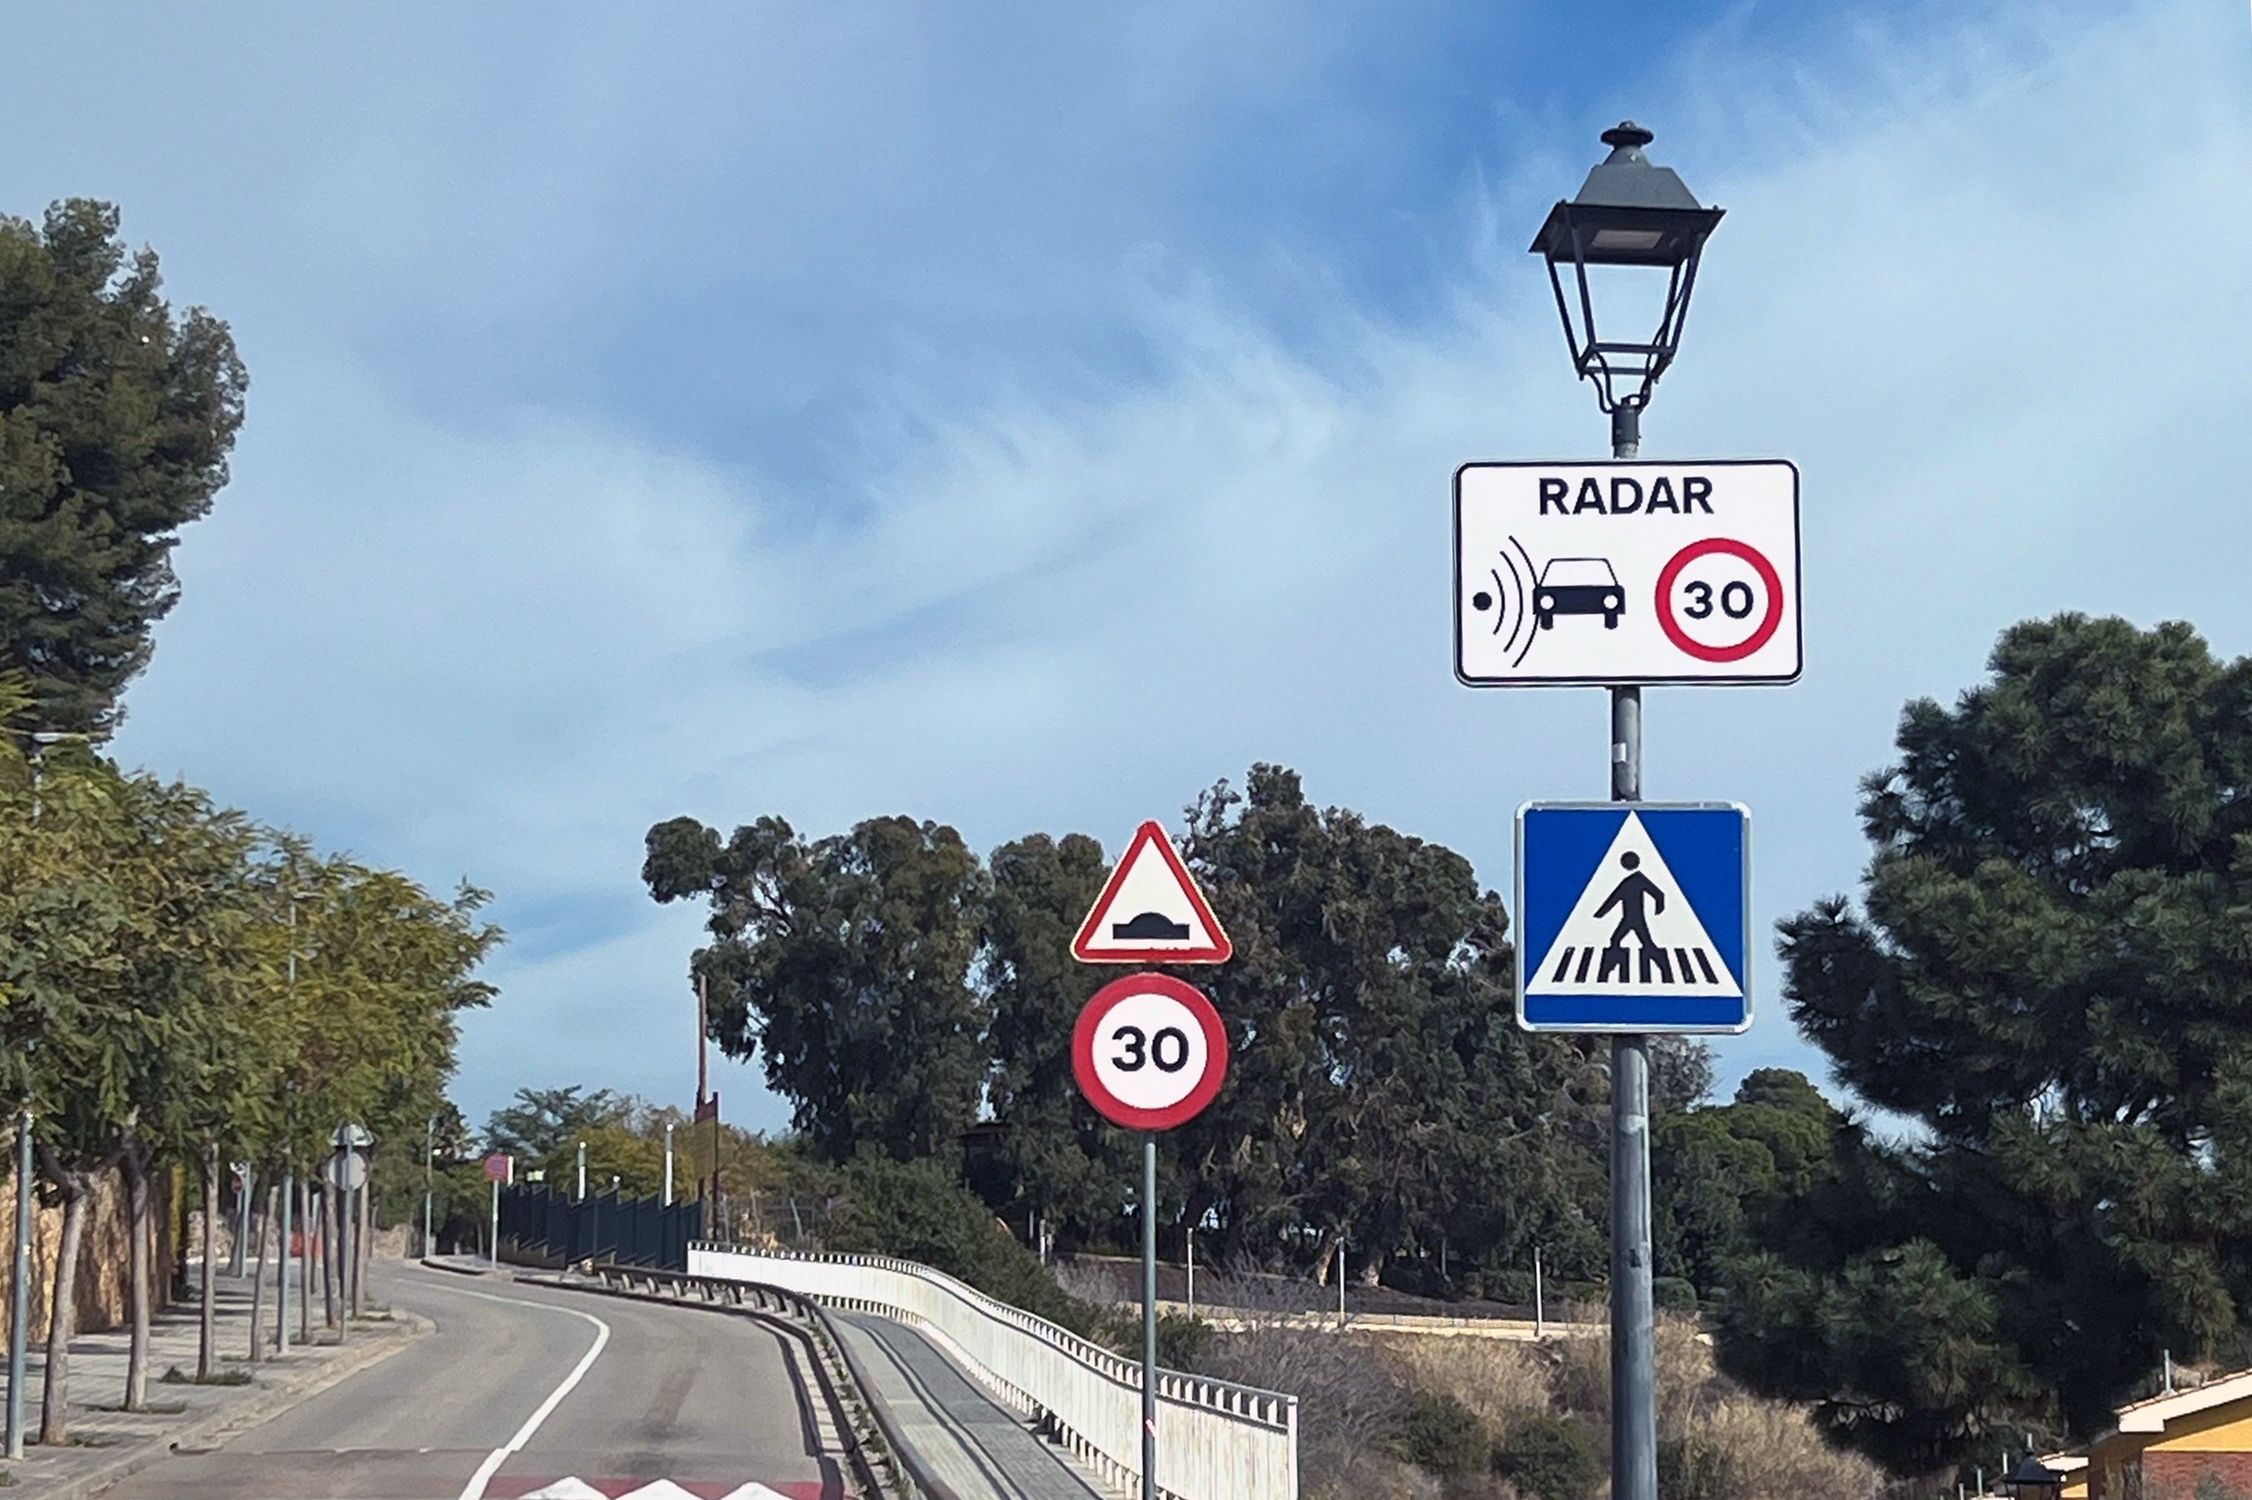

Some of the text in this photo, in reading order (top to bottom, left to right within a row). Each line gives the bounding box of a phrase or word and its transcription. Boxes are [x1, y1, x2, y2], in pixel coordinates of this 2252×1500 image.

[1539, 476, 1714, 515] RADAR
[1683, 580, 1754, 619] 30
[1111, 1025, 1189, 1073] 30
